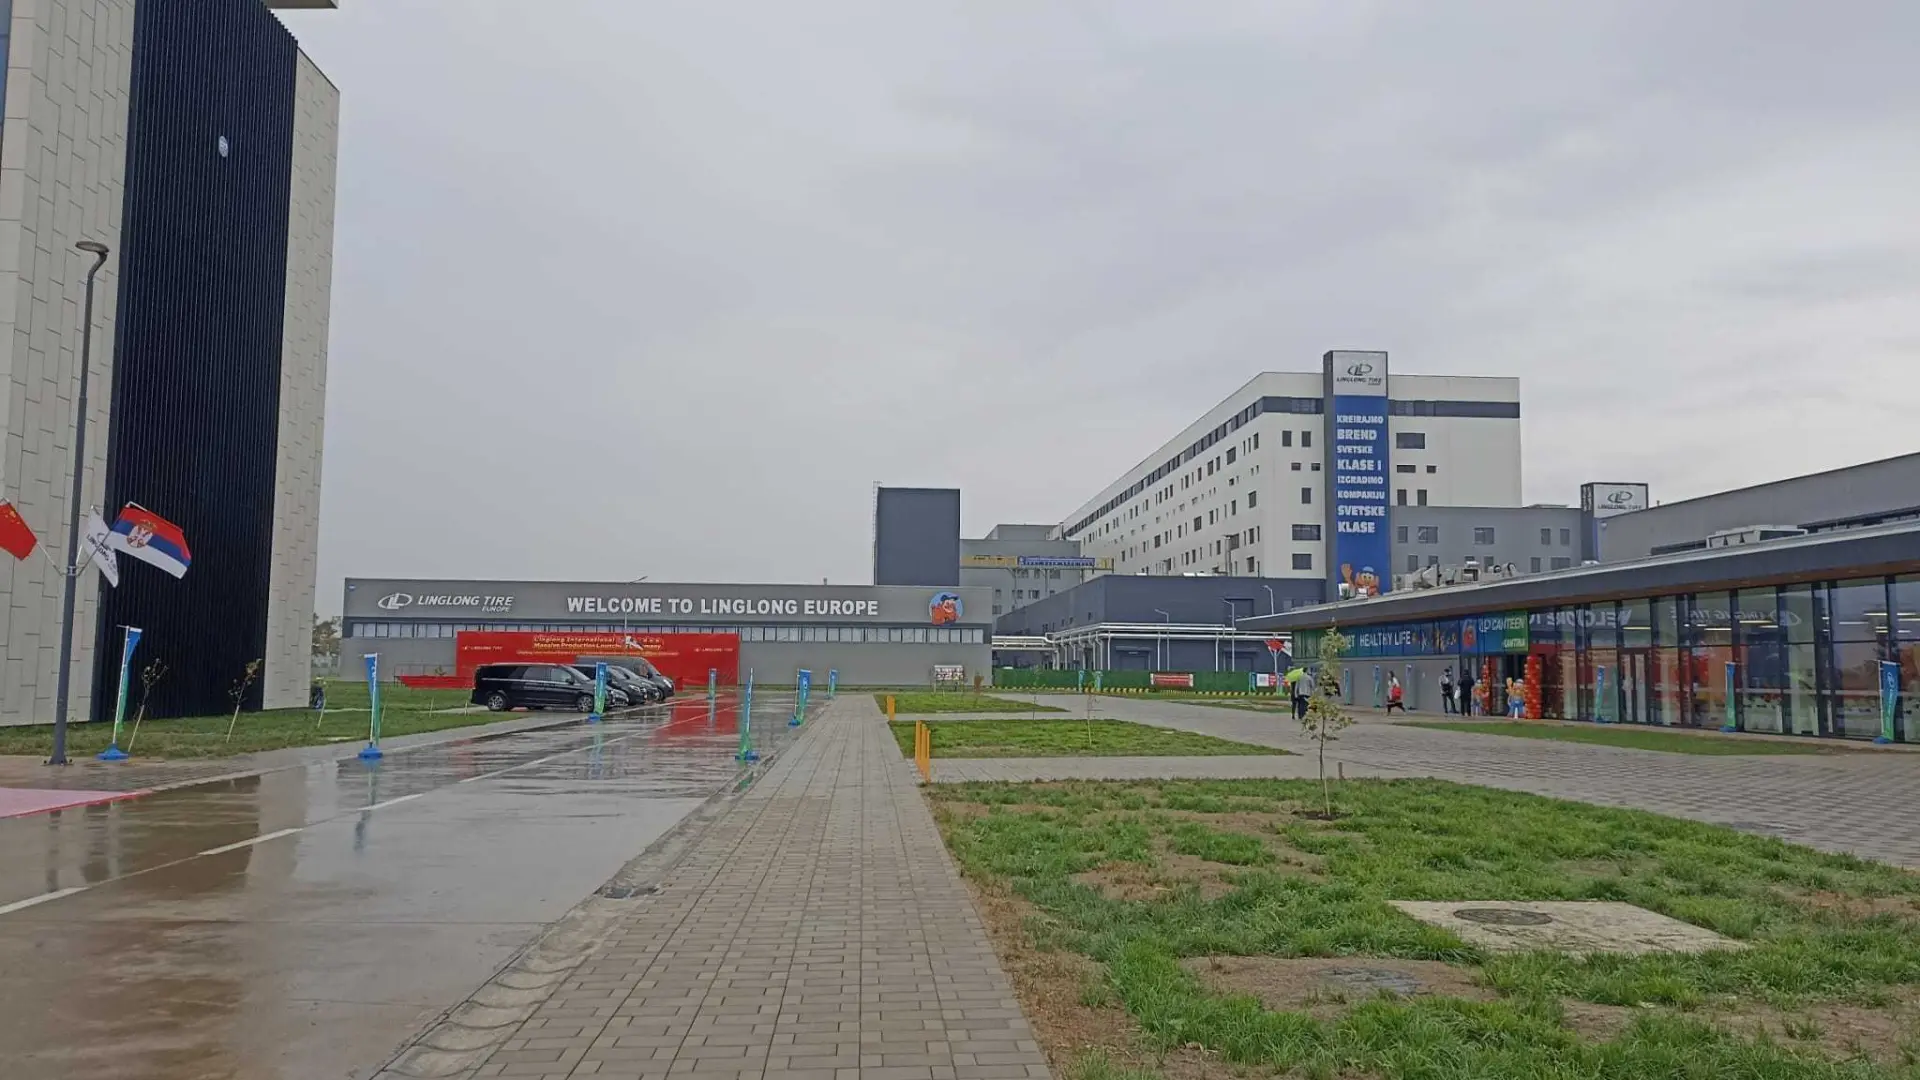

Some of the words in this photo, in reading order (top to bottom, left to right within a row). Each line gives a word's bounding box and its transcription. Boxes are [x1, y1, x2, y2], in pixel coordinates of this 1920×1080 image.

[1336, 415, 1384, 424] KREIRAJMO
[1336, 428, 1378, 440] BREND
[1336, 445, 1373, 454] SVETSKE
[1337, 459, 1374, 471] KLASE
[1377, 460, 1382, 471] I
[1337, 475, 1384, 485] IZGRADIMO
[1337, 490, 1386, 500] KOMPANIJU
[1338, 505, 1386, 517] SVETSKE
[1337, 521, 1376, 533] KLASE
[417, 595, 481, 606] LINGLONG
[483, 595, 515, 606] TIRE
[567, 597, 662, 613] WELCOME
[668, 598, 693, 614] TO
[700, 598, 798, 615] LINGLONG
[803, 599, 878, 615] EUROPE
[1360, 631, 1393, 647] HEALTHY
[1394, 630, 1411, 646] LIFE
